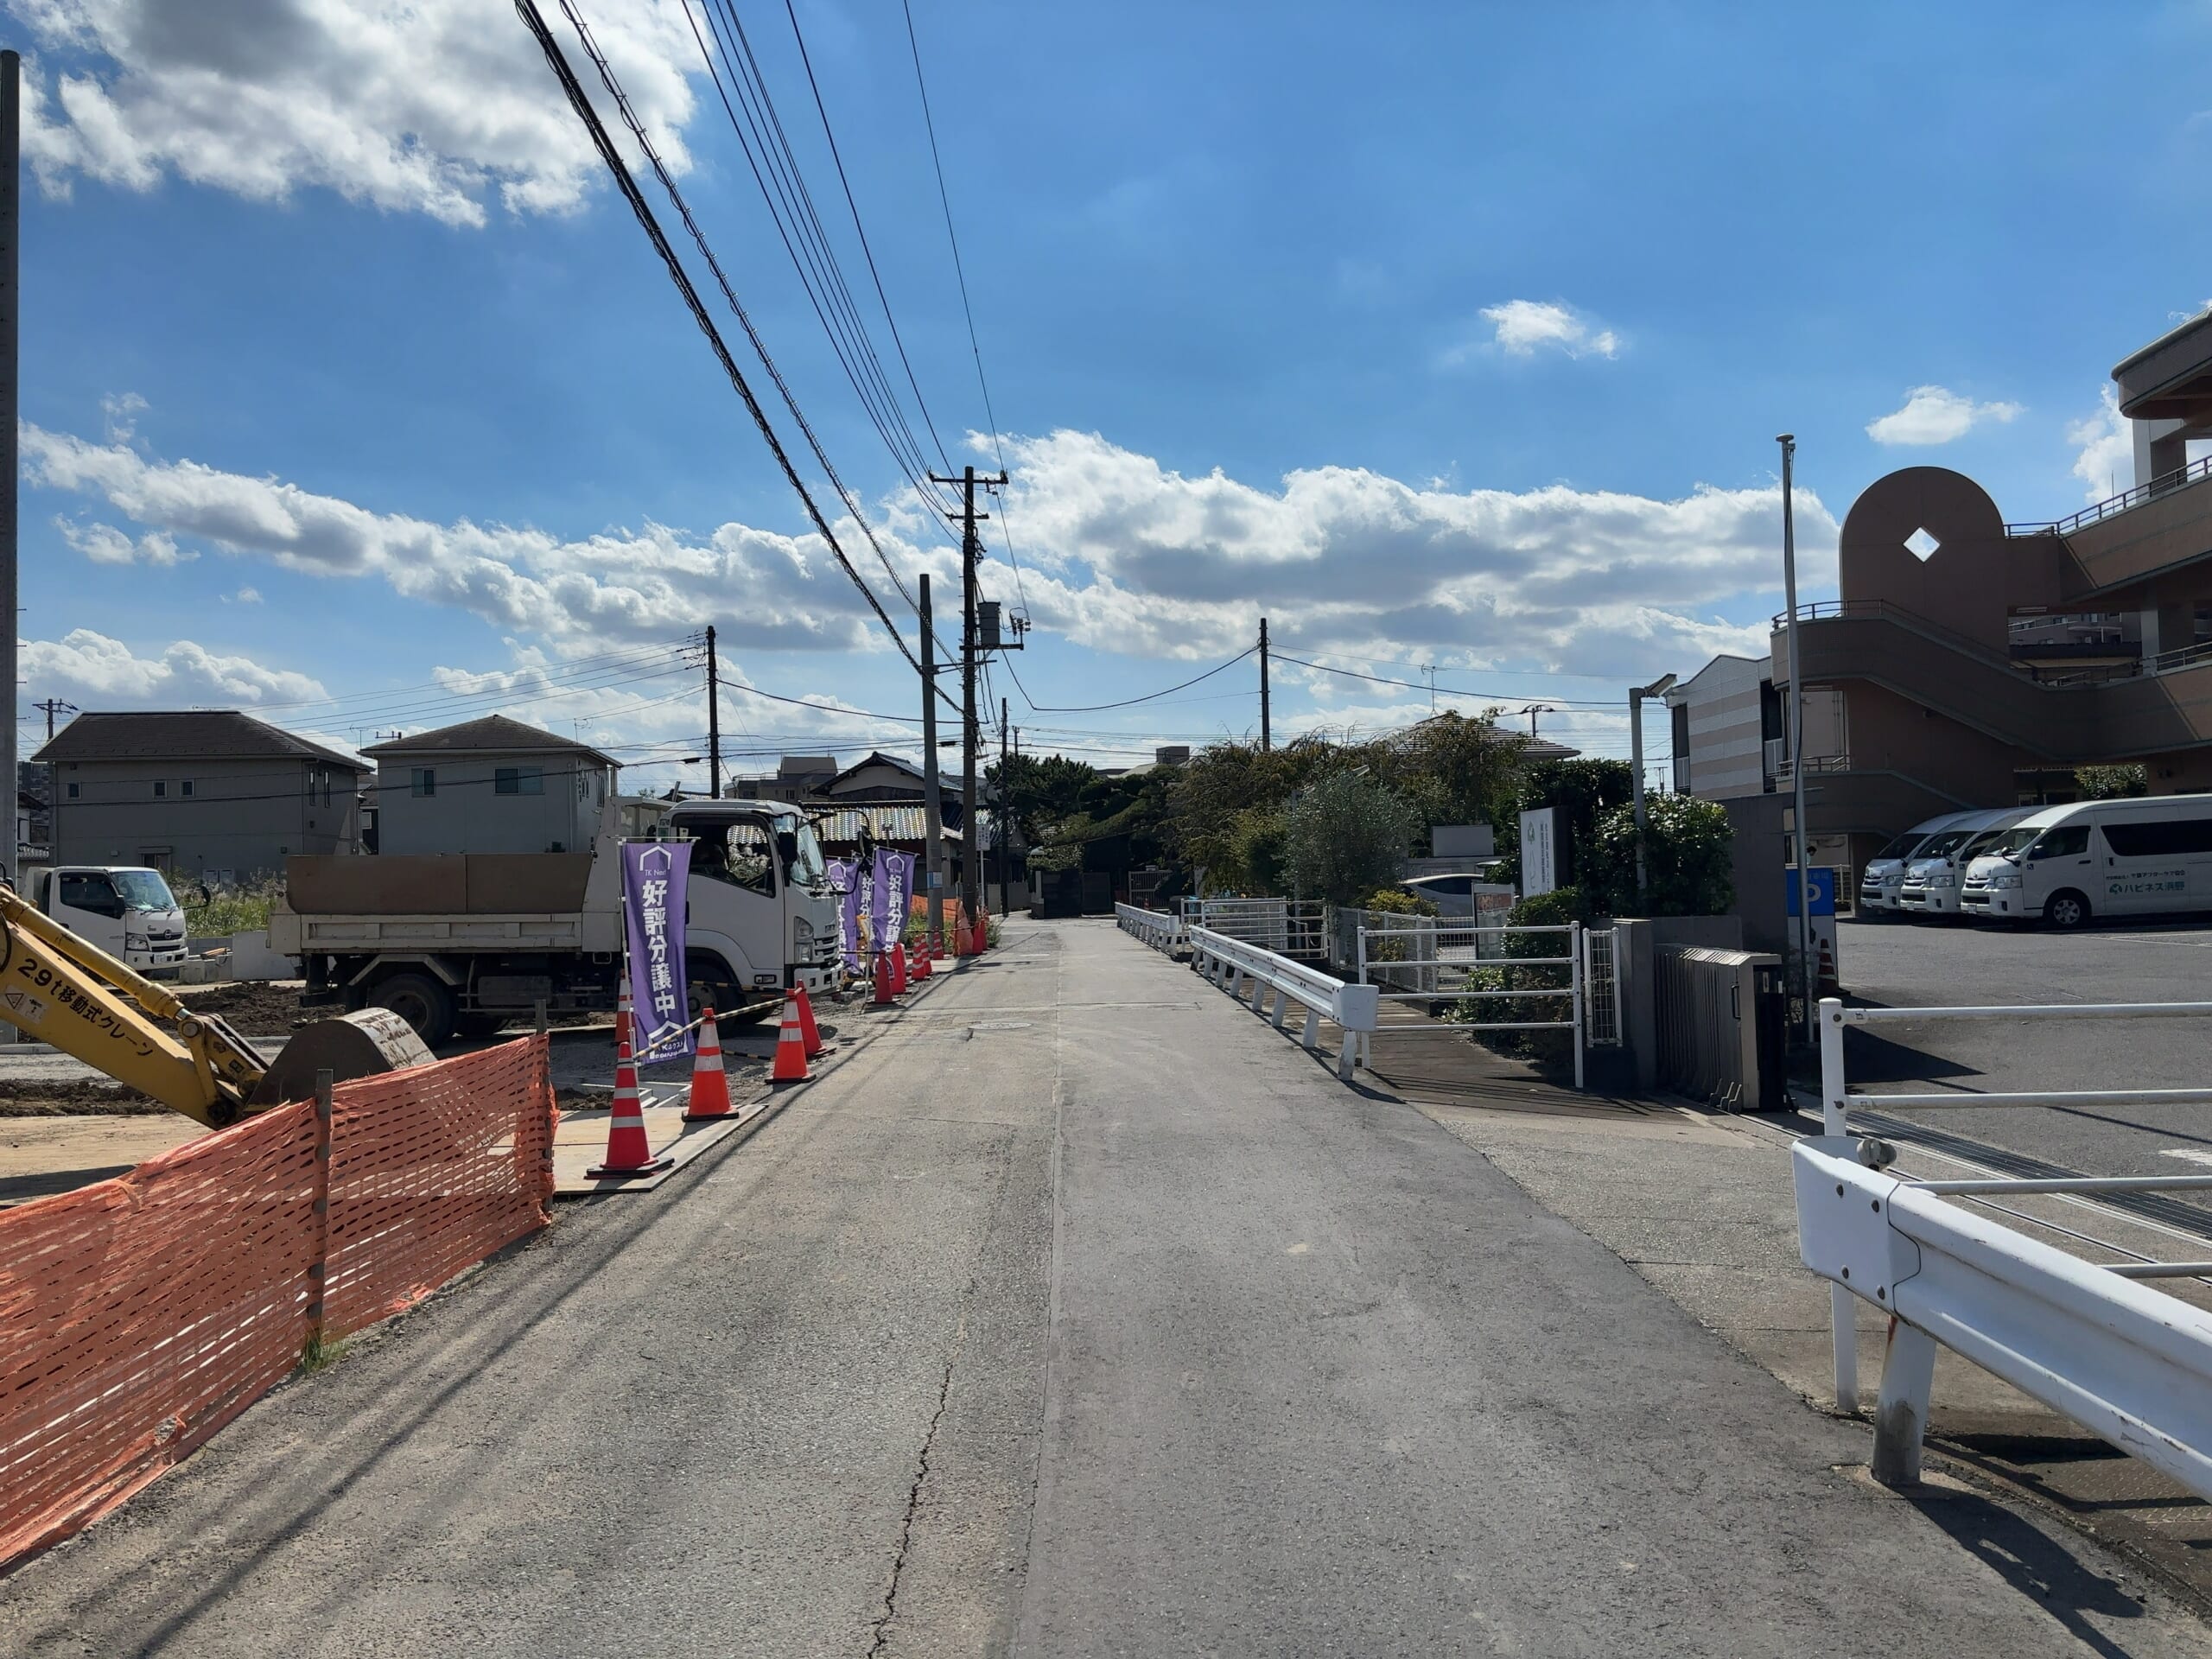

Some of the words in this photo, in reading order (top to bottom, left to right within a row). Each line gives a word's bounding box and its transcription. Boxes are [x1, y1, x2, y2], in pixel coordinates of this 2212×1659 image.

[642, 880, 676, 1019] 好評分譲中
